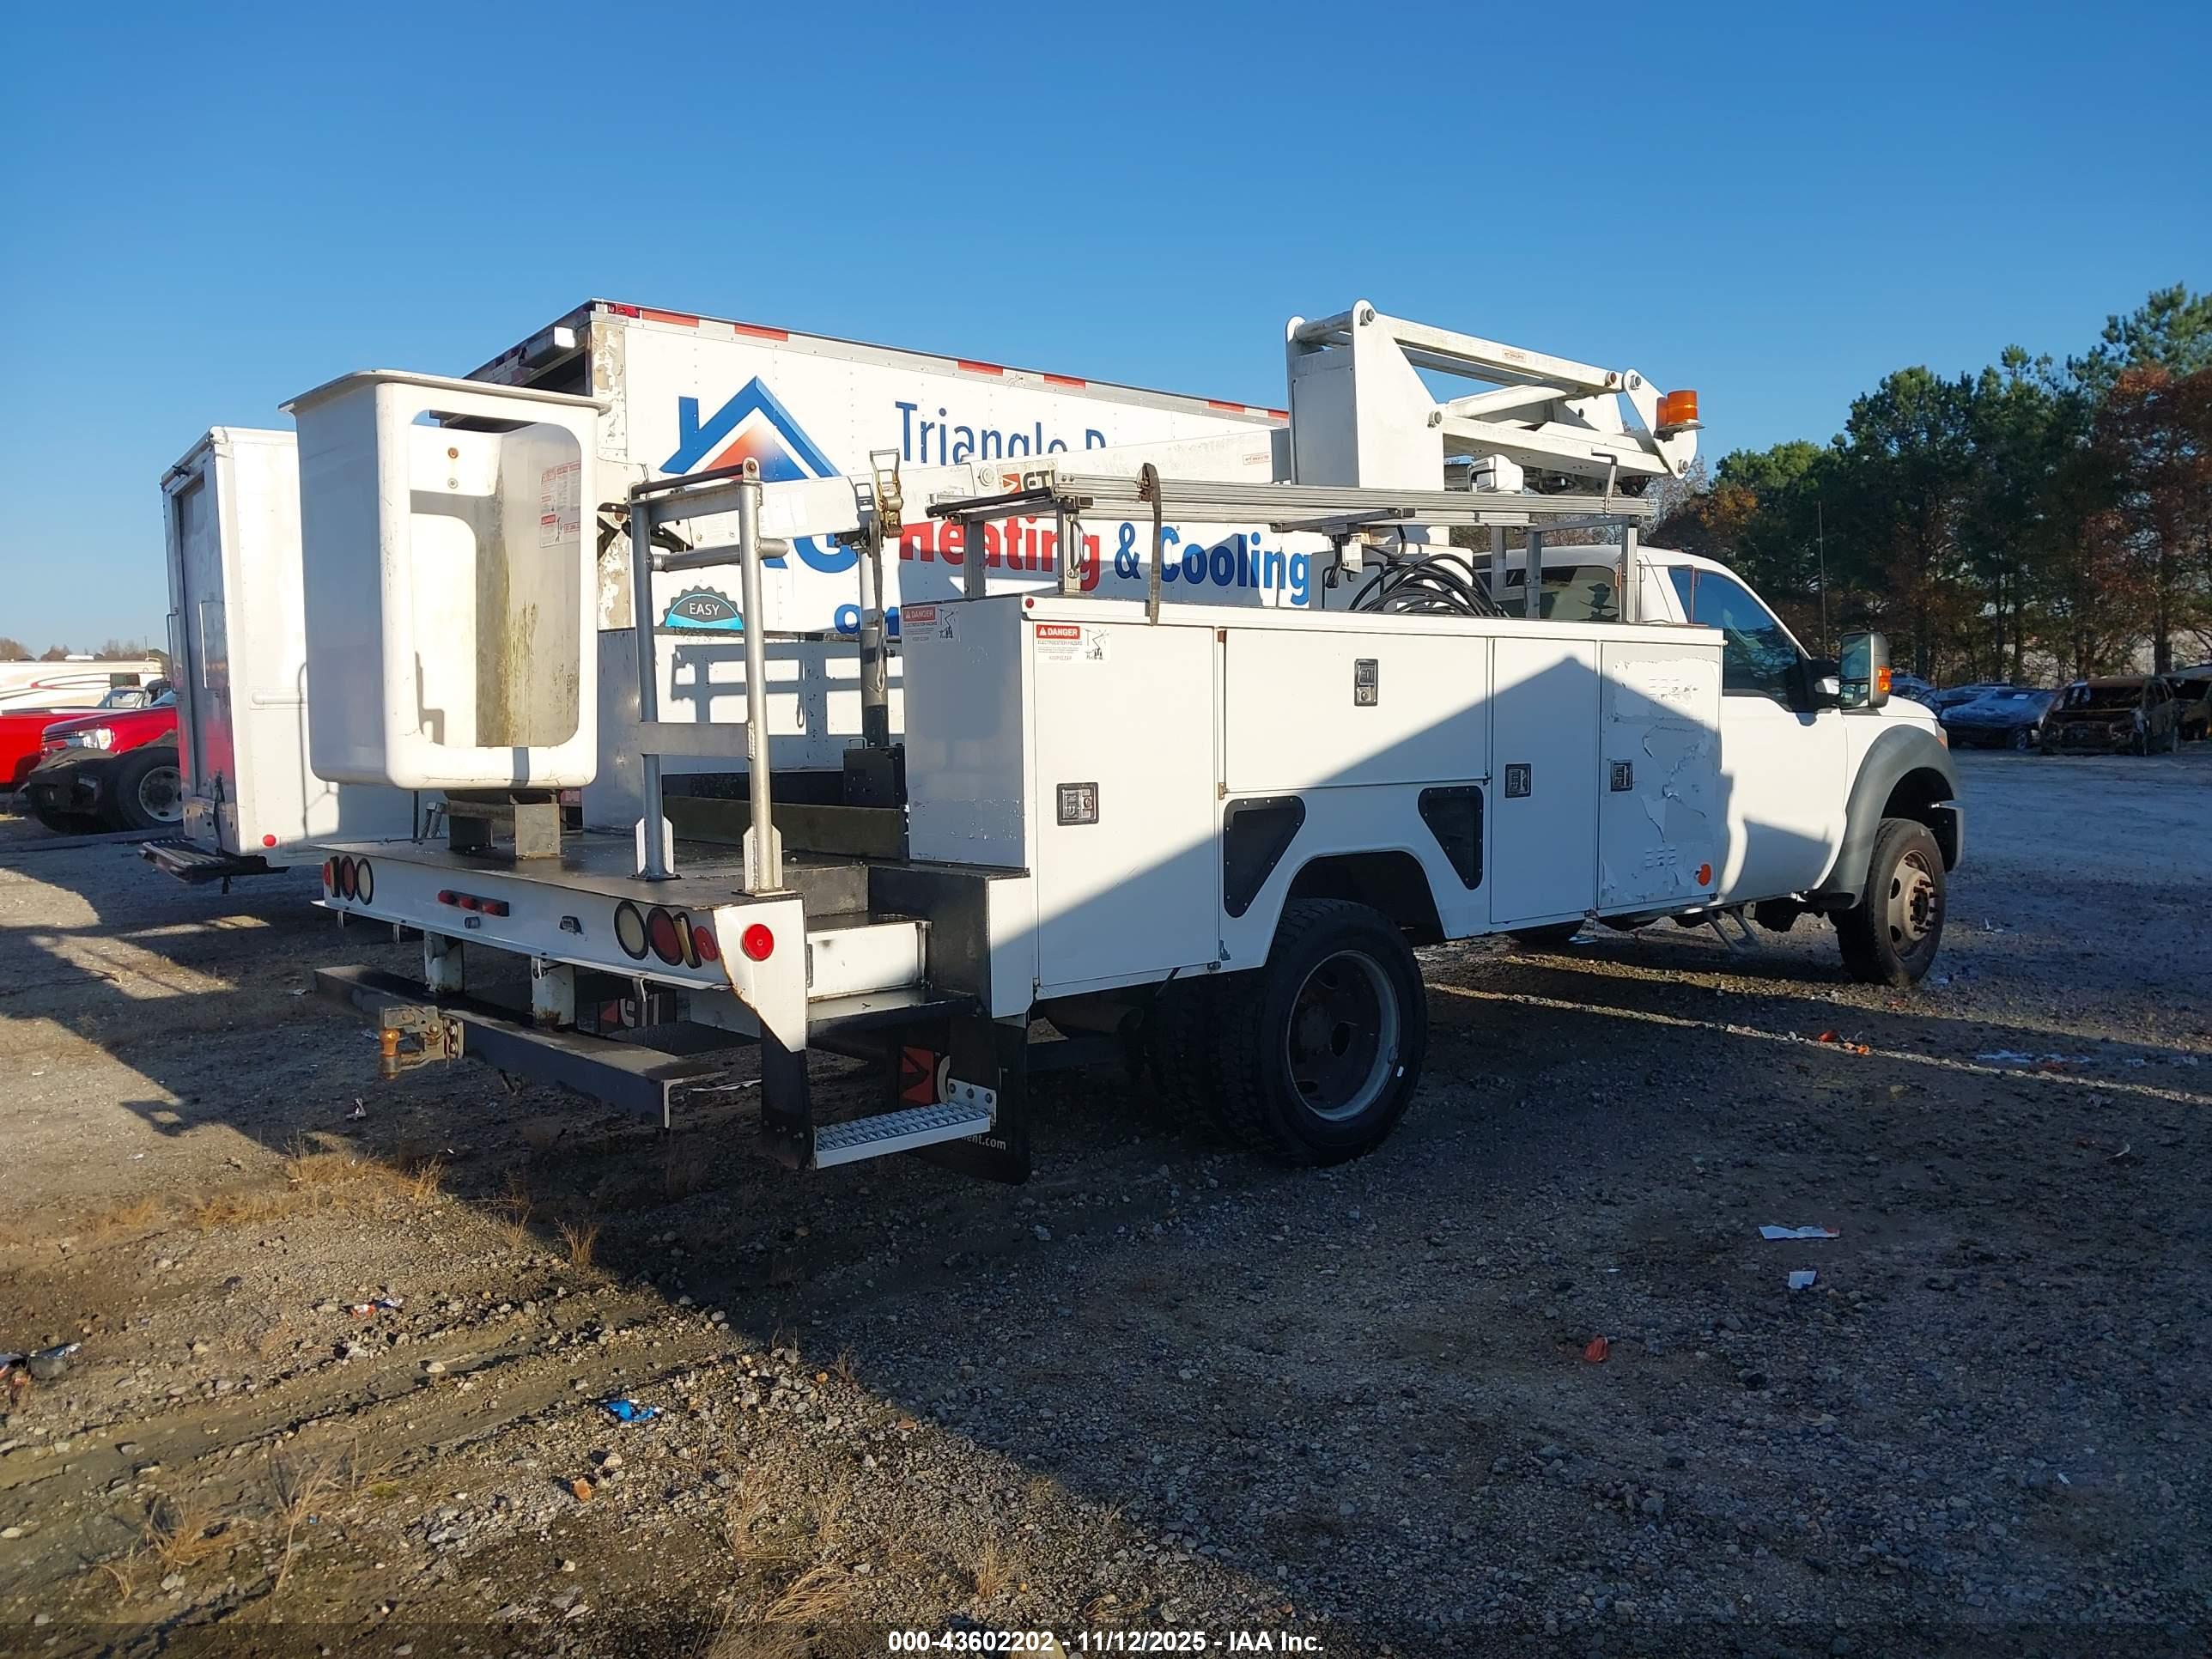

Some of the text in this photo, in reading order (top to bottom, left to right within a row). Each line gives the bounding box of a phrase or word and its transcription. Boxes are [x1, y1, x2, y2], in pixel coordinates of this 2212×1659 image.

[1114, 522, 1142, 580] &
[1161, 526, 1310, 605] Cooling
[689, 603, 720, 616] EASY
[911, 610, 933, 618] DANGER
[1047, 628, 1078, 637] DANGER
